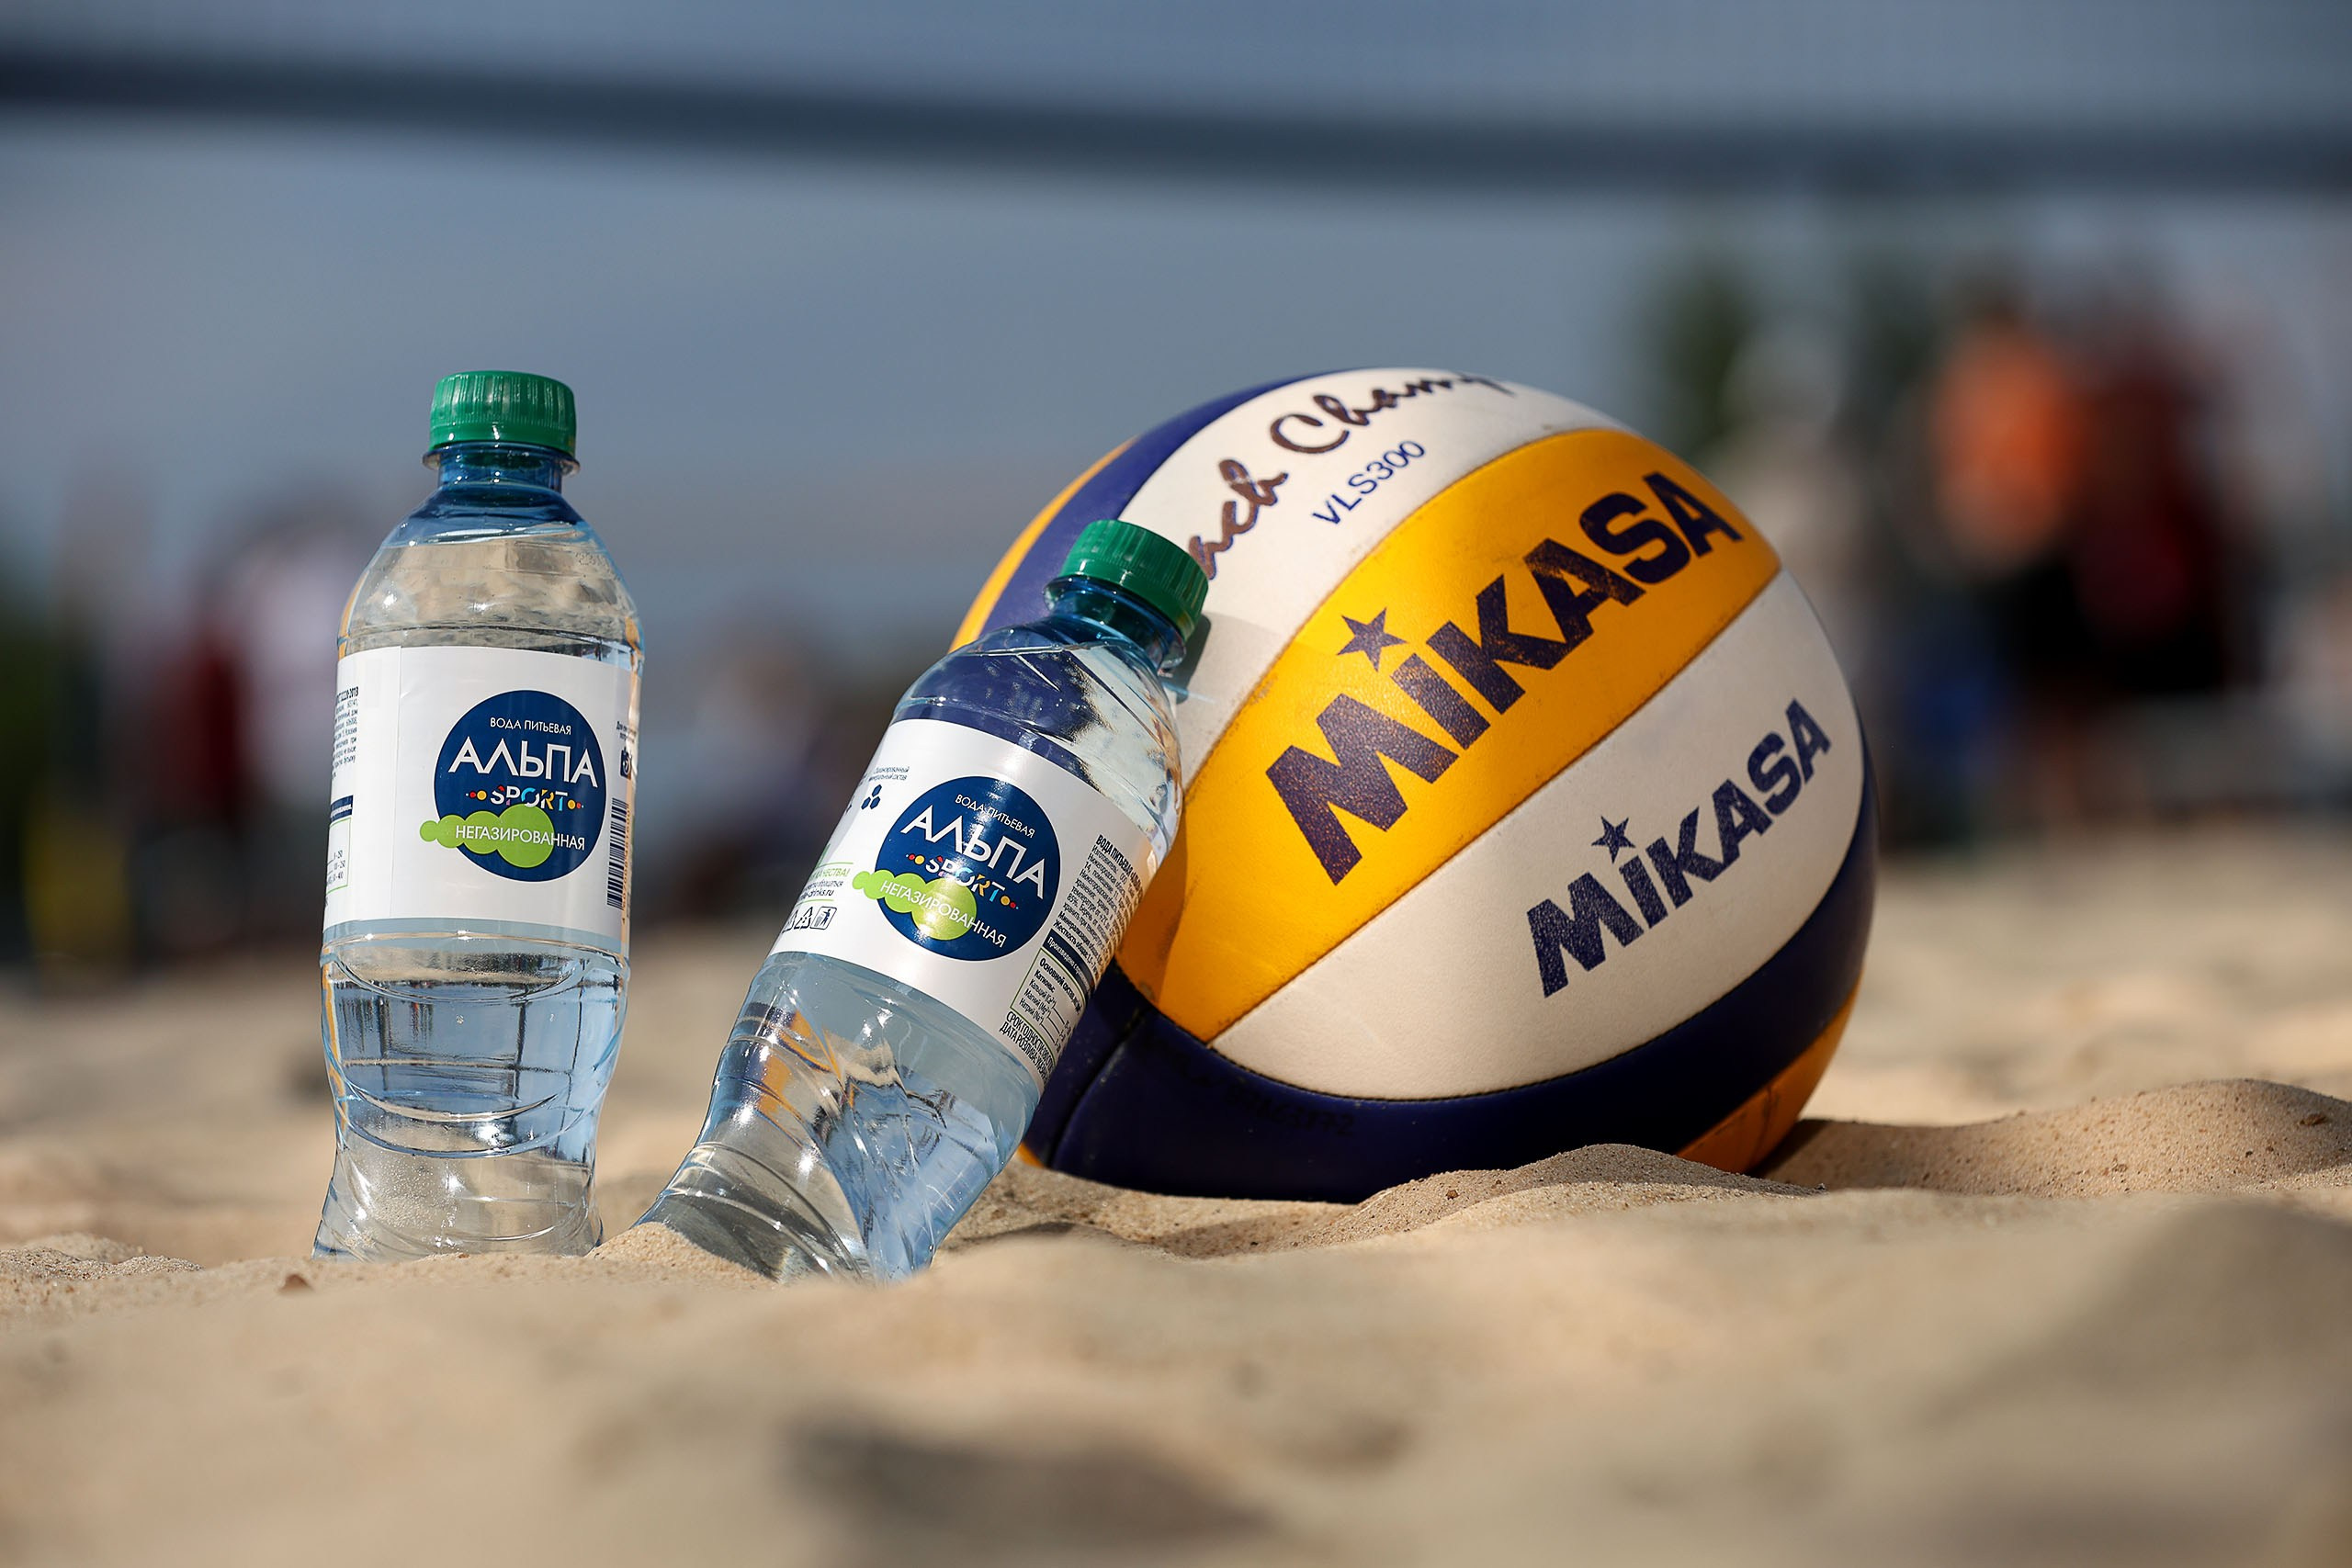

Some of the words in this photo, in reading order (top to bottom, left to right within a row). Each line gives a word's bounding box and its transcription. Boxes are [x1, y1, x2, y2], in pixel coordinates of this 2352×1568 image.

[1311, 440, 1426, 526] VLS300
[490, 716, 522, 729] ВОДА
[524, 719, 571, 736] ПИТЬЕВАЯ
[447, 736, 598, 788] АЛЬПА
[490, 784, 569, 812] SPORT
[955, 794, 985, 813] ВОДА
[987, 807, 1035, 839] ПИТЬЕВАЯ
[455, 825, 586, 852] НЕГАЗИРОВАННАЯ
[899, 804, 1045, 900] АЛЬПА
[1096, 834, 1115, 854] ВОДА
[1110, 848, 1134, 876] ПИТЬЕВАЯ
[924, 855, 1006, 902] SPORT
[1062, 901, 1080, 920] хранить
[1070, 886, 1096, 913] температуре
[879, 880, 1007, 948] НЕГАЗИРОВАННАЯ
[1053, 919, 1078, 945] Жесткость
[1046, 936, 1074, 966] Произведено
[1038, 957, 1066, 986] Основной
[1019, 998, 1036, 1015] Натрий
[1023, 987, 1042, 1007] Магний
[999, 1021, 1020, 1042] ДАТА
[1006, 1010, 1024, 1030] СРОК
